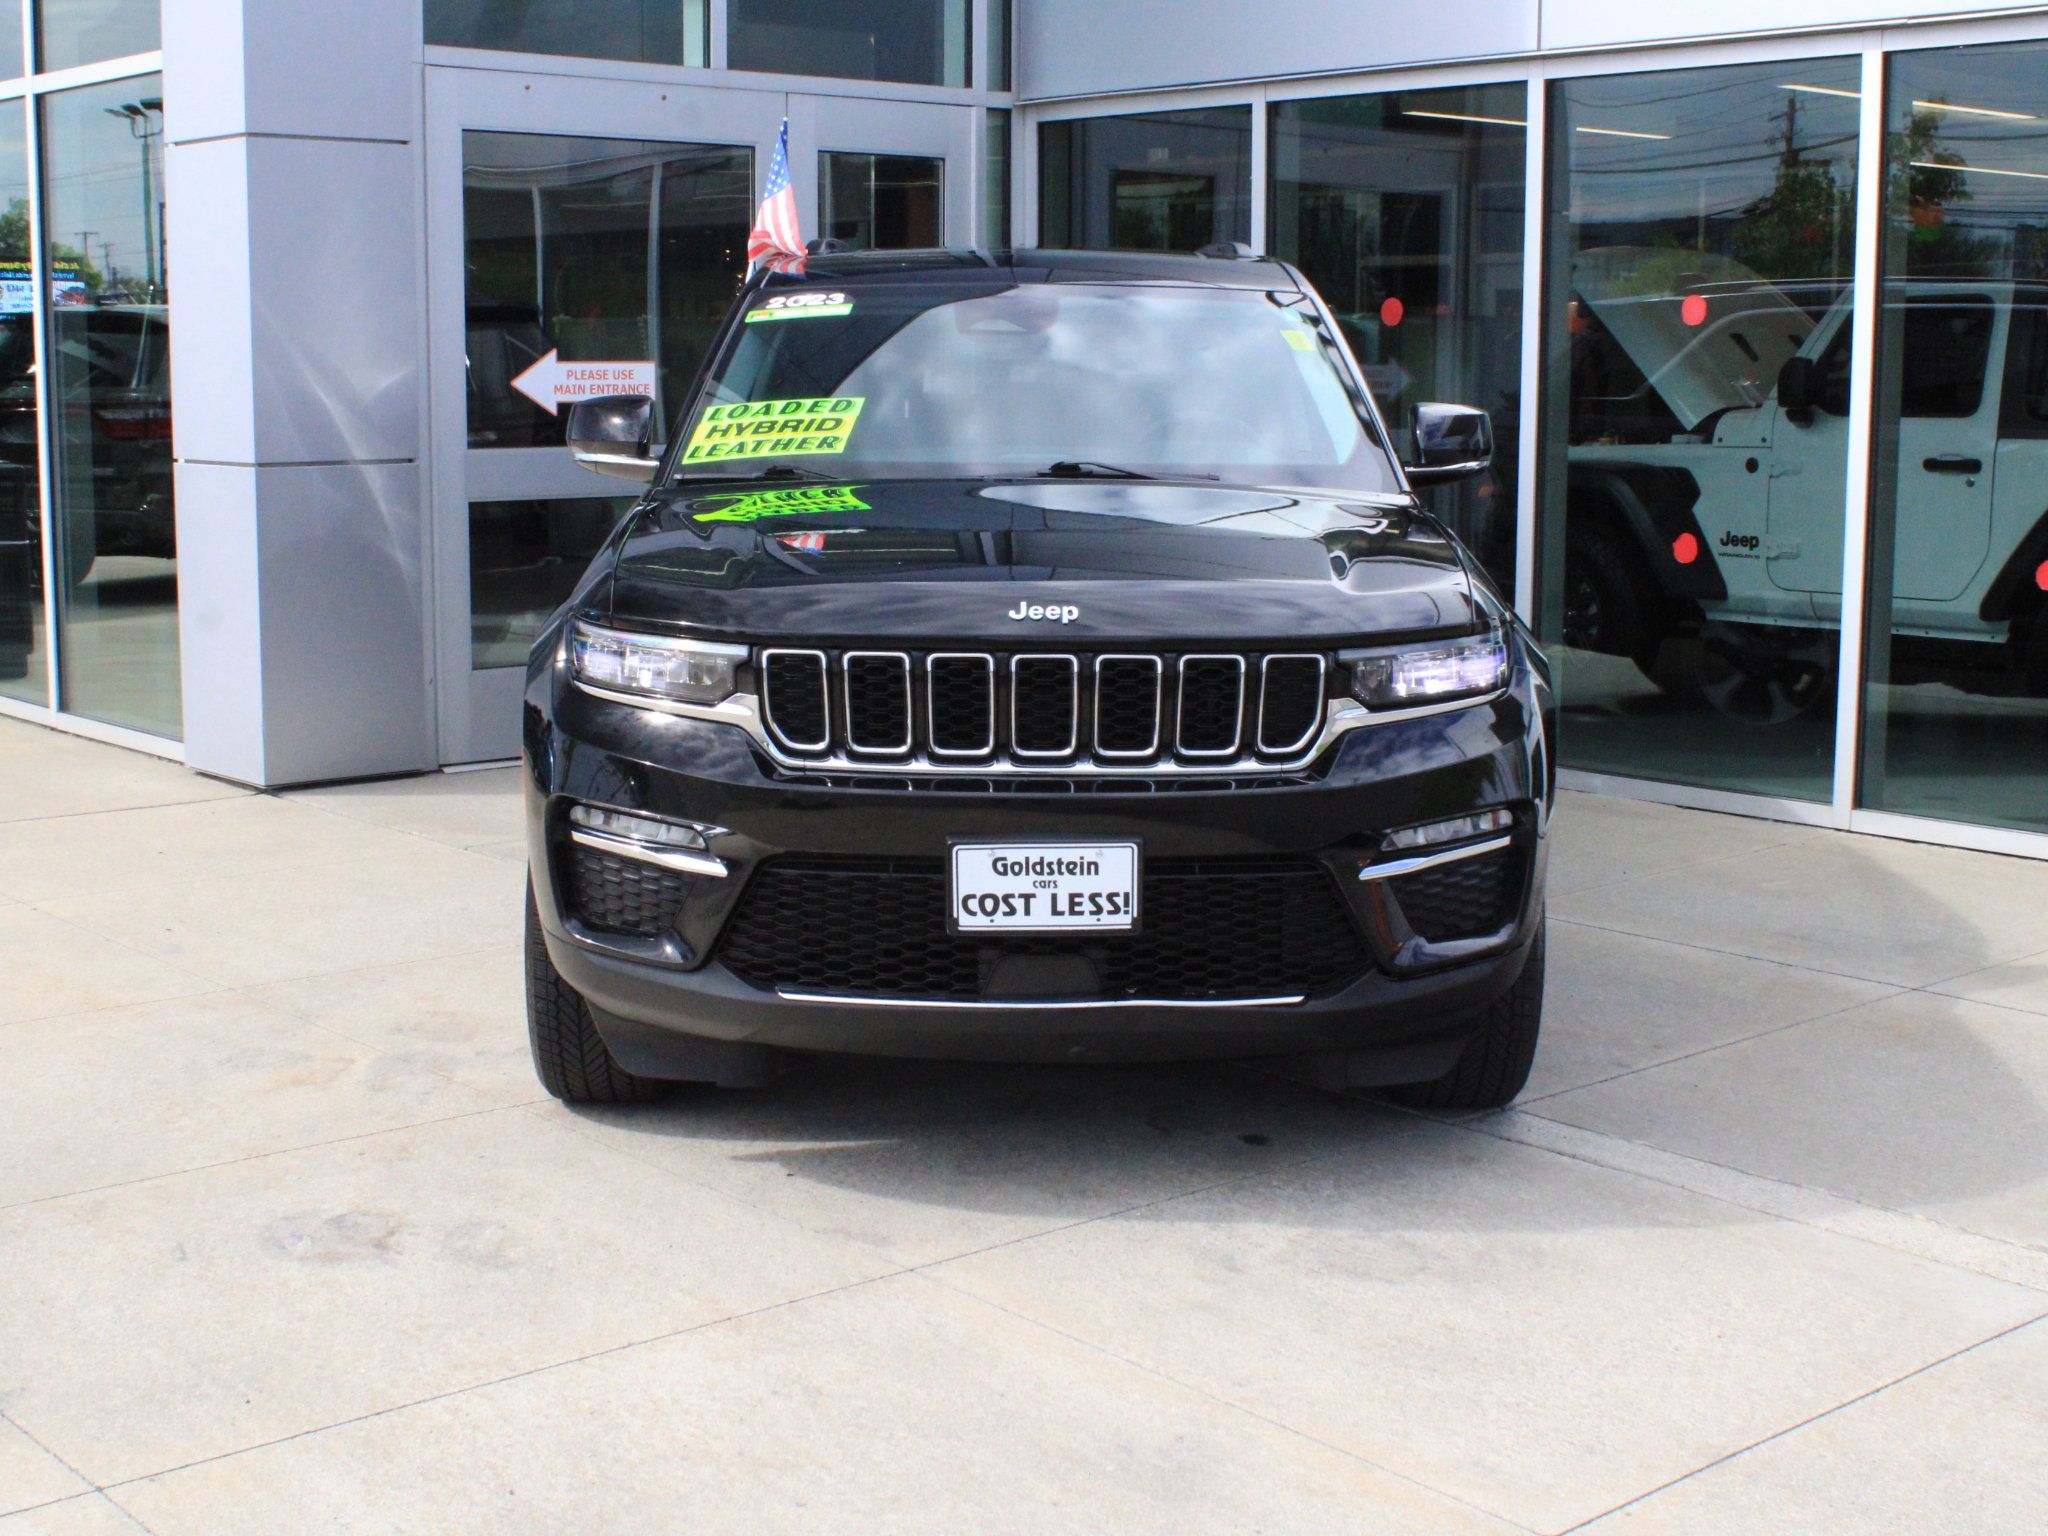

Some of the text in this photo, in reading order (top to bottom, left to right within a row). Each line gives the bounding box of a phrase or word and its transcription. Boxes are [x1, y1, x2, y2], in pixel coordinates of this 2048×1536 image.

[766, 292, 846, 309] 2023
[566, 369, 635, 381] PLEASE USE
[554, 383, 651, 395] MAIN ENTRANCE
[707, 399, 854, 422] LOADED
[704, 417, 844, 440] HYBRID
[686, 435, 841, 460] LEATHER
[1719, 530, 1760, 551] Jeep
[1008, 601, 1080, 625] Jeep
[991, 856, 1100, 877] Goldstein
[1032, 880, 1059, 889] cars
[961, 891, 1131, 918] COST LESS!
